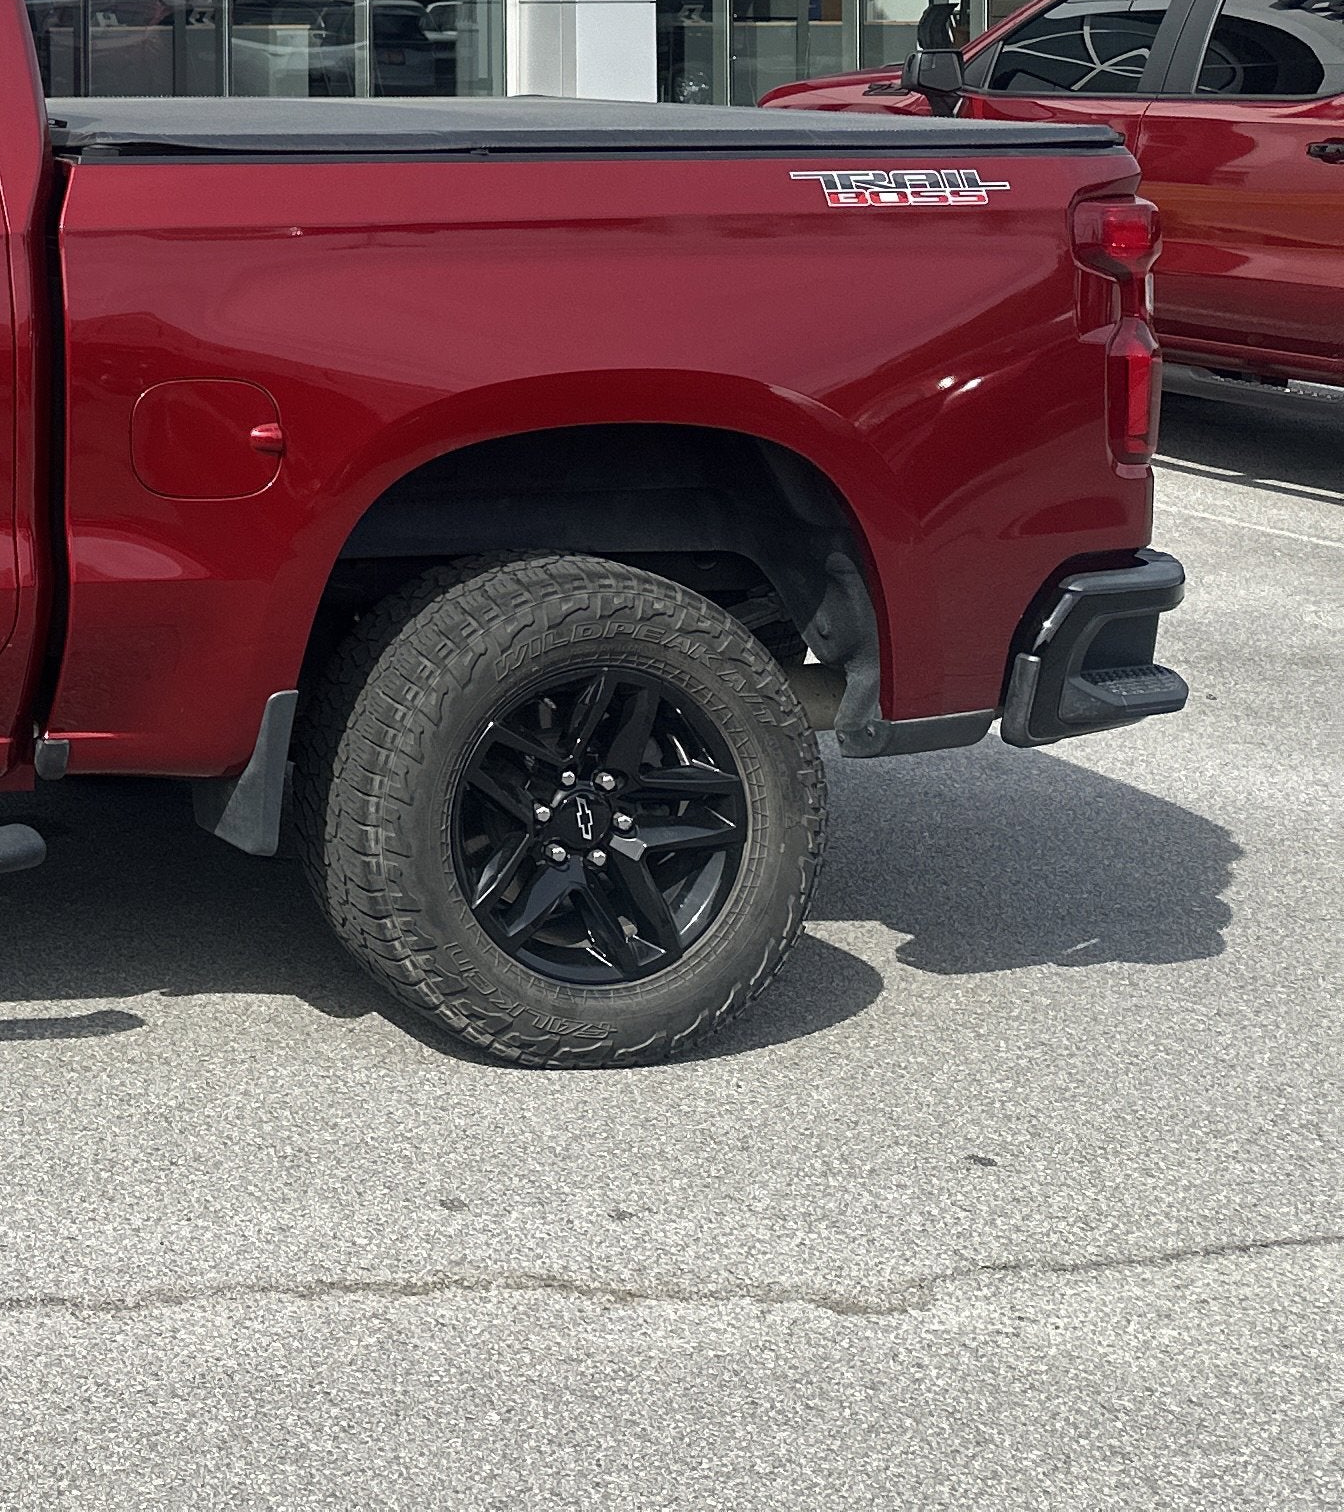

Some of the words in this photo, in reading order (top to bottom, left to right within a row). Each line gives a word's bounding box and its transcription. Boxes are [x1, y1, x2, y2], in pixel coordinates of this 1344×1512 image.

[789, 169, 1011, 190] TRAIL
[825, 188, 988, 207] BOSS
[495, 619, 723, 682] WILDPEAK
